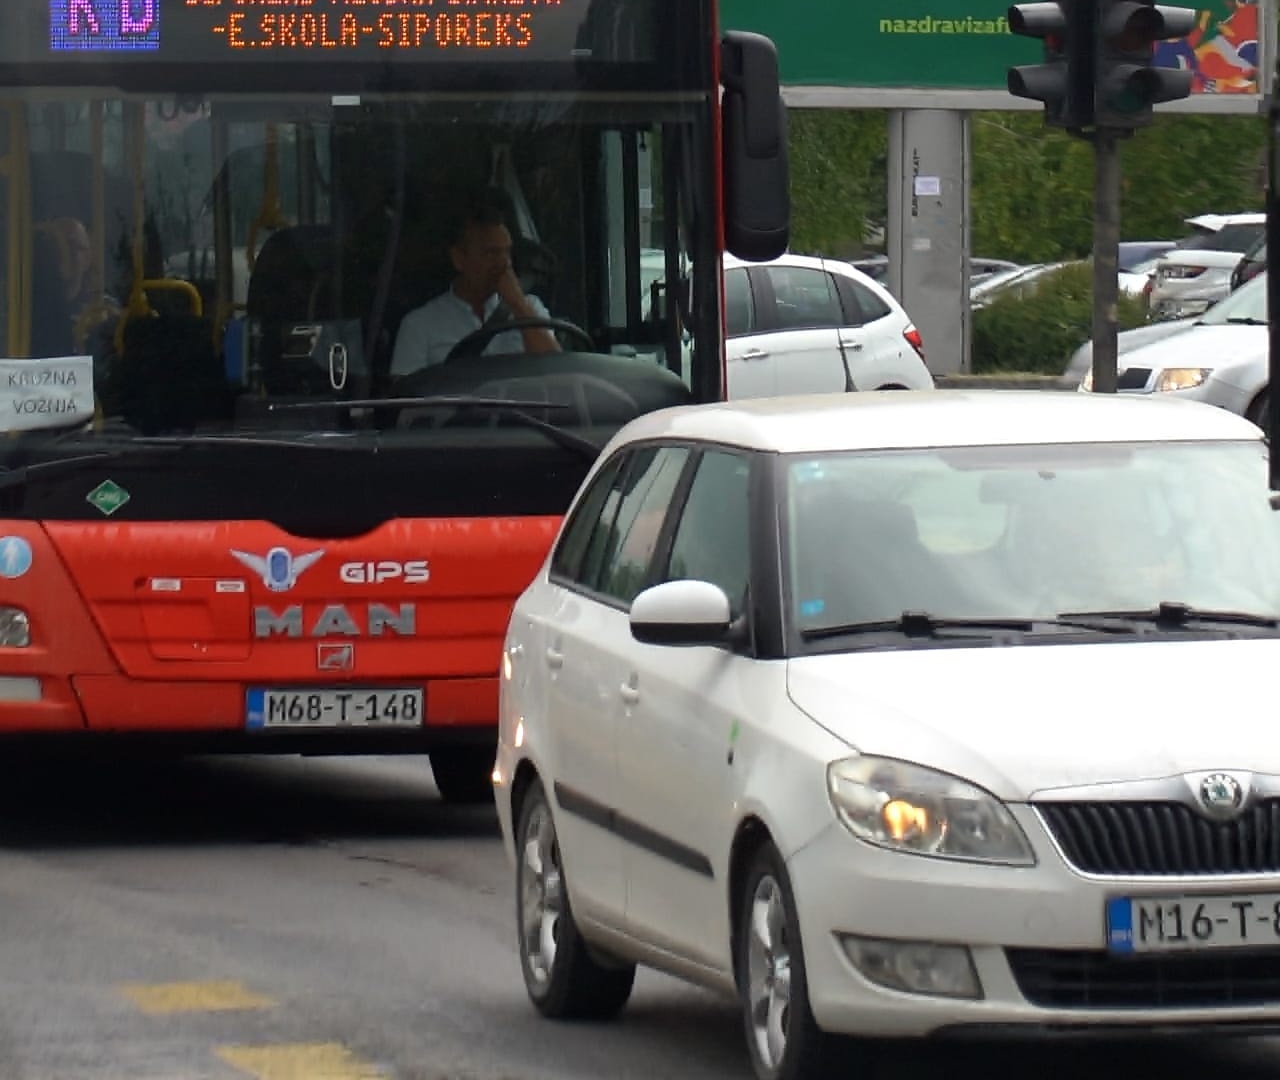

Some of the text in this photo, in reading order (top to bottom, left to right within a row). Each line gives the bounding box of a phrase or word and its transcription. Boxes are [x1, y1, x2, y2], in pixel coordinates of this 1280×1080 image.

[340, 561, 430, 584] GIPS
[254, 603, 417, 638] MAN
[267, 693, 418, 722] M68-T-148
